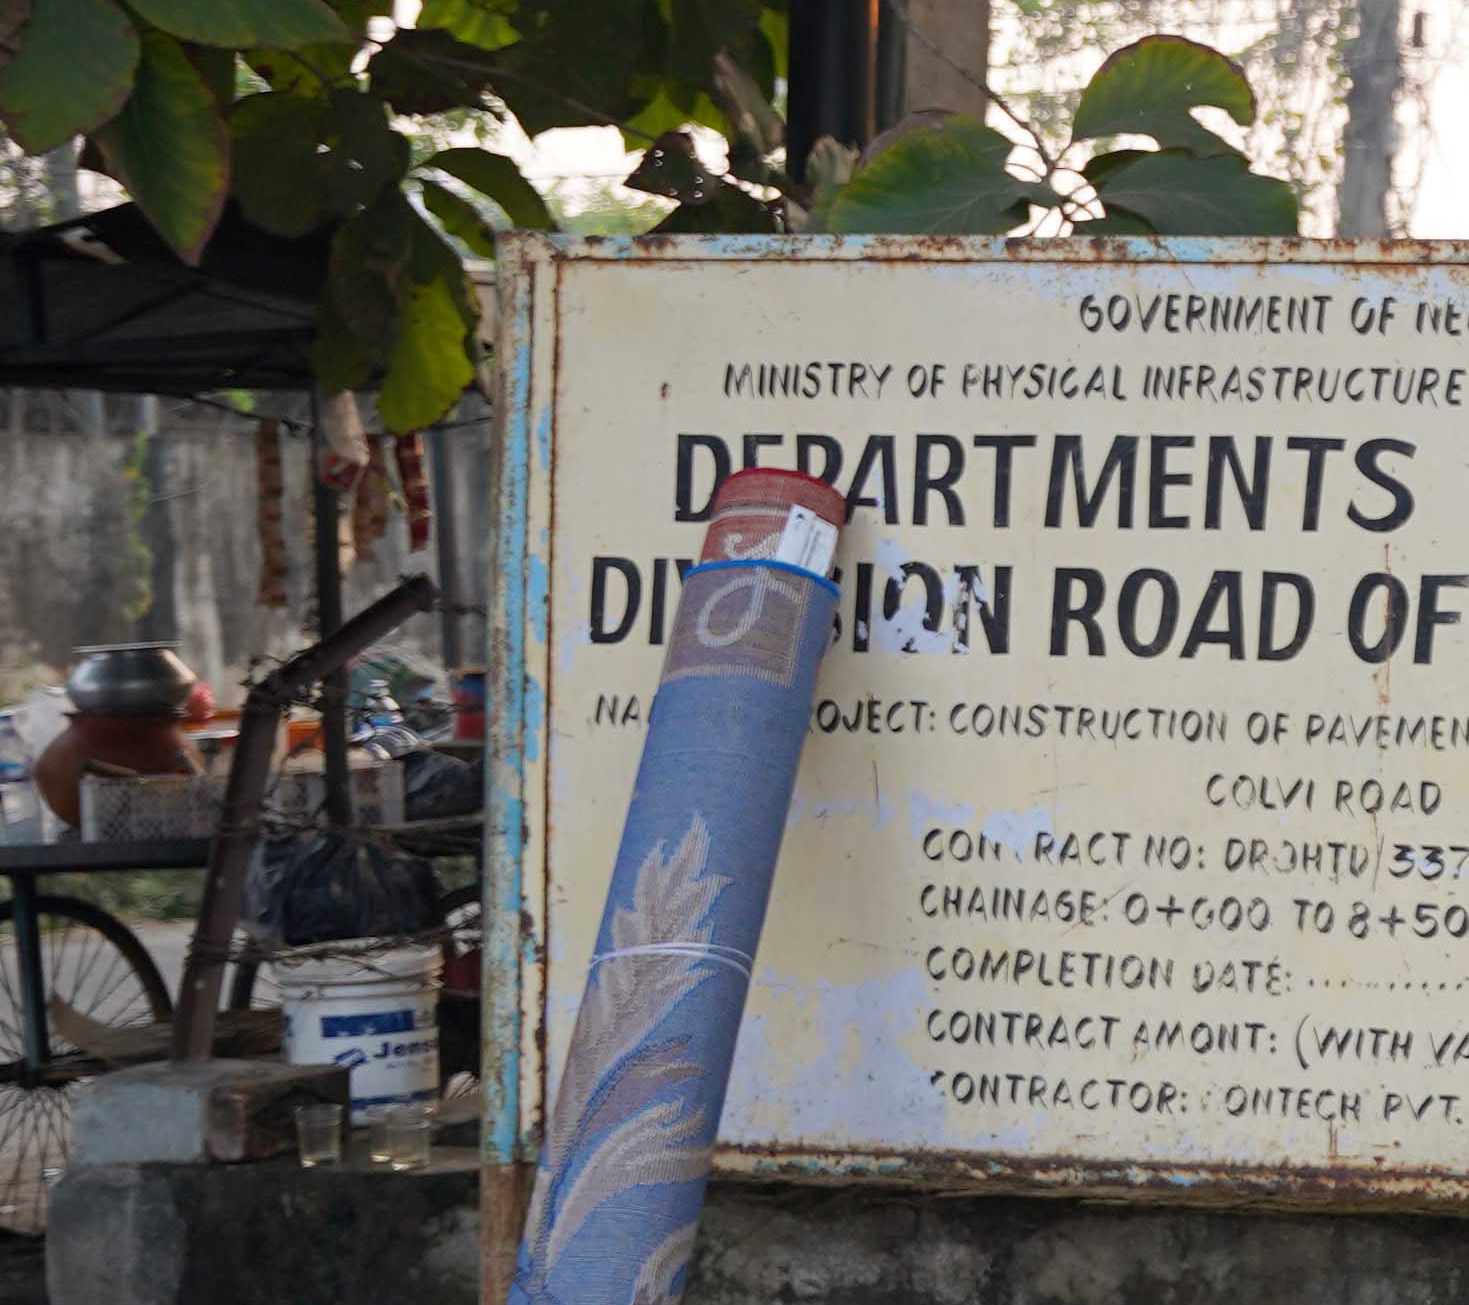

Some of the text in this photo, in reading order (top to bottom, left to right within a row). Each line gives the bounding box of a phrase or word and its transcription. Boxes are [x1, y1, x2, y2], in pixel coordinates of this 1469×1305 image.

[1080, 294, 1332, 335] GOVERNMENT
[1351, 297, 1398, 336] OF
[724, 362, 892, 400] MINISTRY
[908, 365, 945, 396] OF
[963, 364, 1126, 402] PHYSICAL
[1144, 365, 1466, 406] INFRASTRUCTURE
[1049, 566, 1316, 662] ROAD
[810, 698, 936, 734] OJECT:
[950, 702, 1227, 744] CONSTRUCTION
[1247, 704, 1289, 741] OF
[1334, 778, 1442, 816] ROAD
[923, 829, 1131, 865] CONRACT
[1144, 837, 1205, 869] NO:
[920, 884, 1110, 926] CHAINAGE:
[1293, 898, 1334, 934] TO
[926, 946, 1293, 997] COMPLETION DATE:
[926, 1008, 1121, 1051] CONTRACT
[1132, 1019, 1278, 1055] AMONT:
[1295, 1013, 1413, 1069] (WITH
[1383, 1090, 1461, 1126] PVT.
